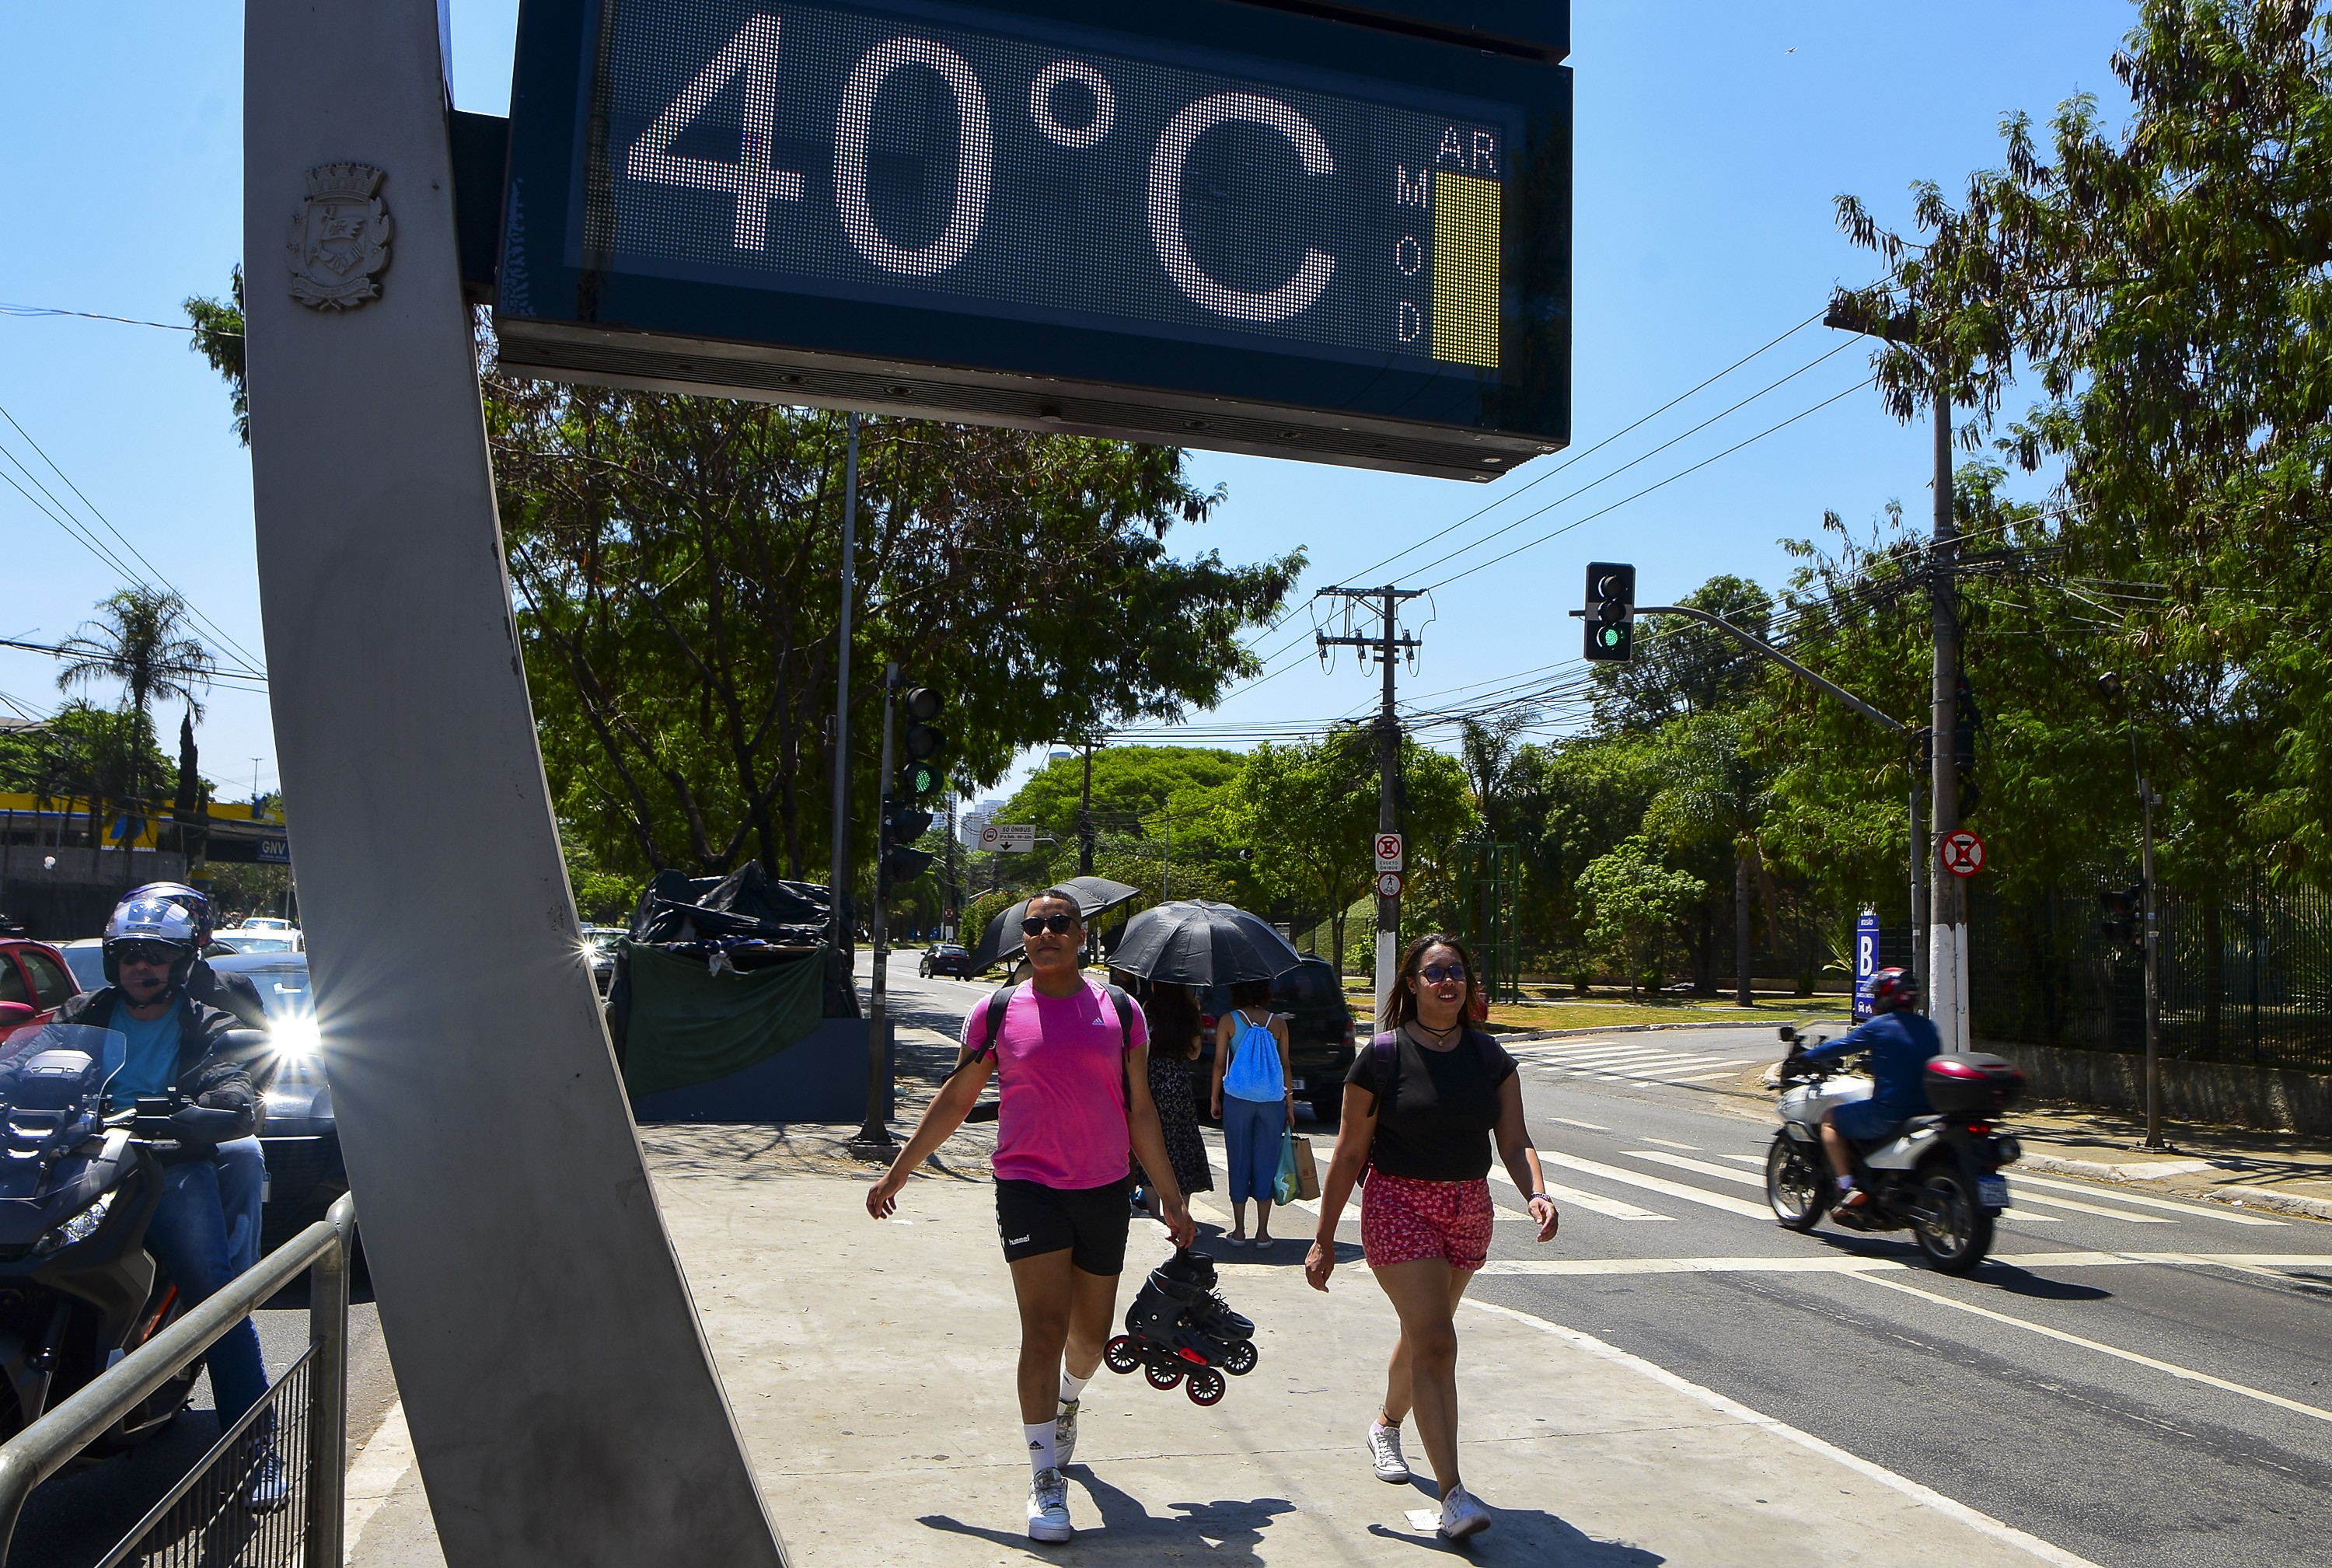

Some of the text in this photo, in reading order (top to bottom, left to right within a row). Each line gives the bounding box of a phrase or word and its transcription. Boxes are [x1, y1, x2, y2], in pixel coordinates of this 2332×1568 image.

[1436, 126, 1497, 173] AR
[262, 840, 286, 854] GNV
[1859, 935, 1873, 976] B
[1008, 1234, 1030, 1245] hummel
